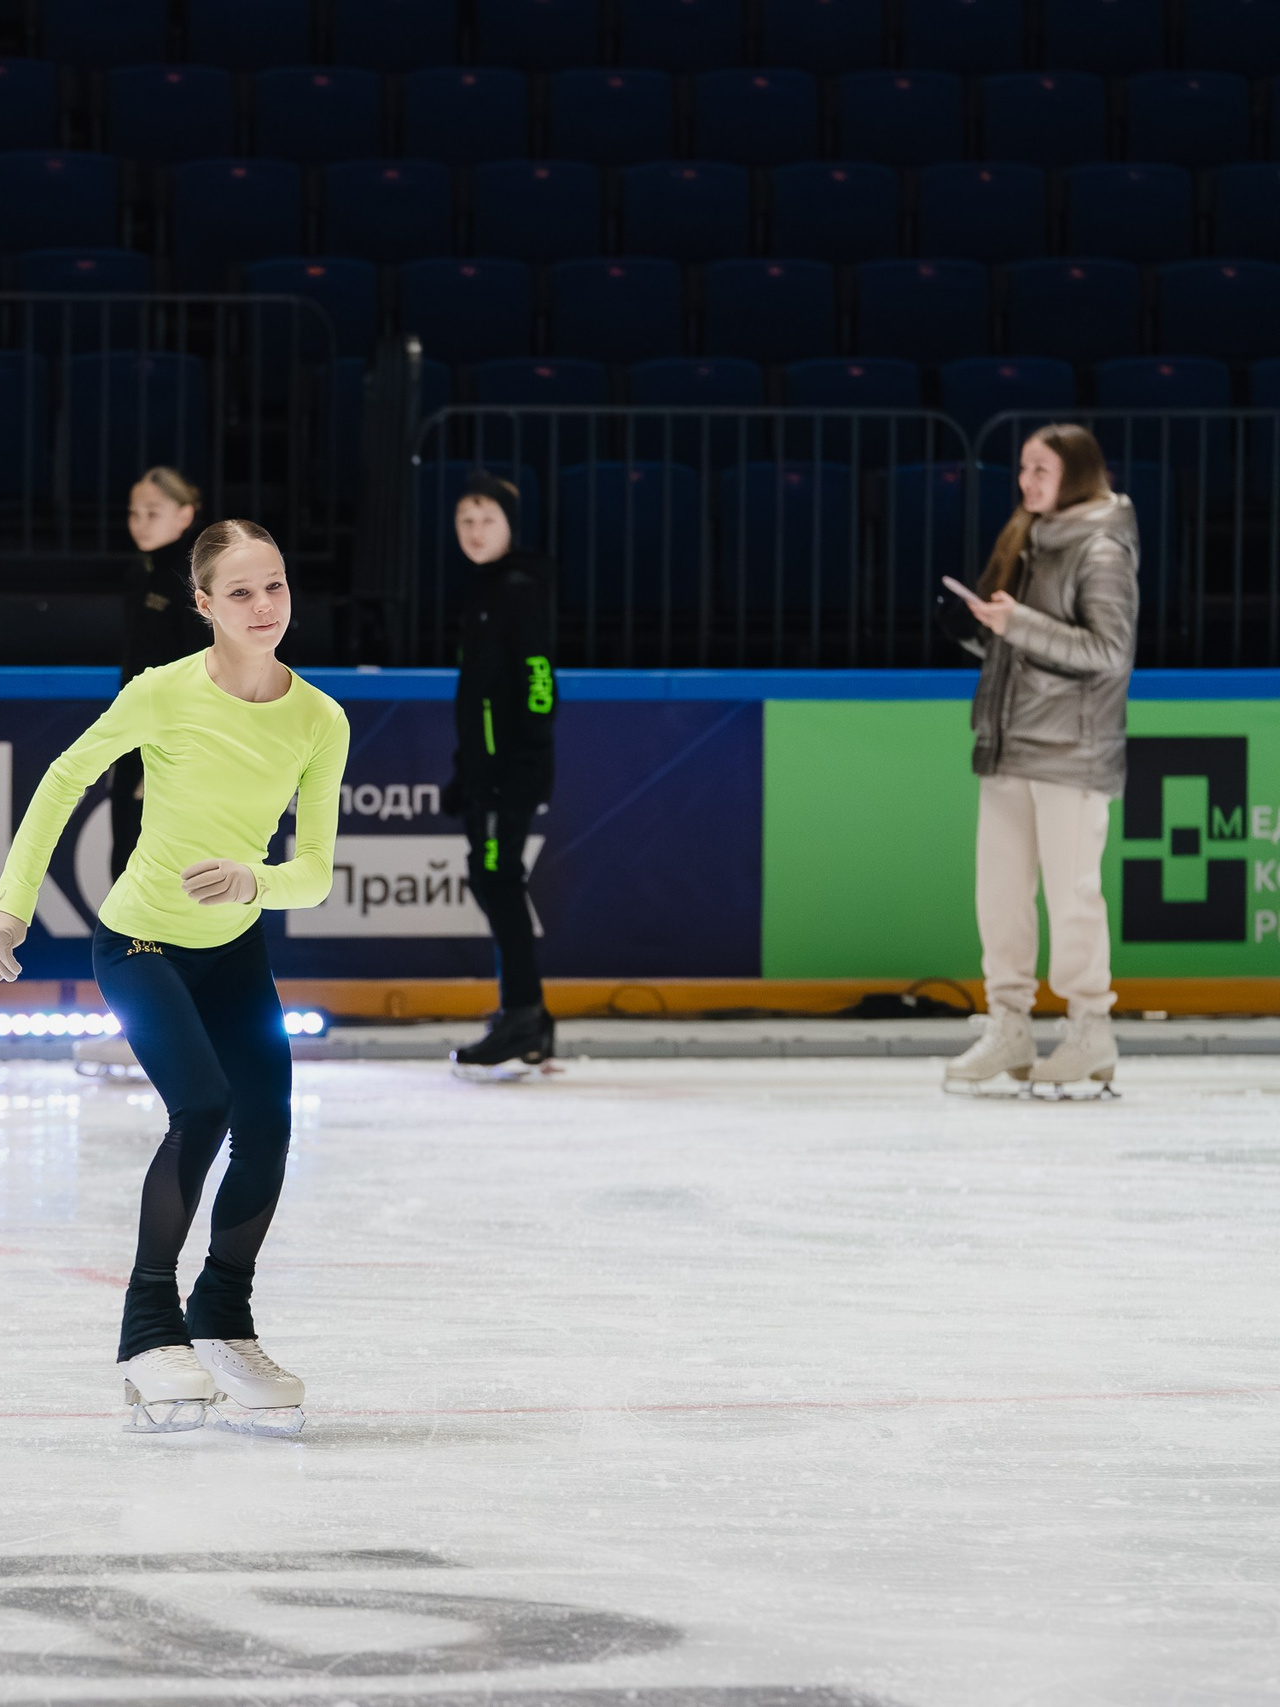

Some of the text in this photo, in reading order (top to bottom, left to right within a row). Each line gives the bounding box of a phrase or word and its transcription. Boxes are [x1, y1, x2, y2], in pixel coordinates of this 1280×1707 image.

[333, 858, 470, 917] Прай
[1253, 859, 1280, 892] К
[1254, 909, 1280, 943] Р
